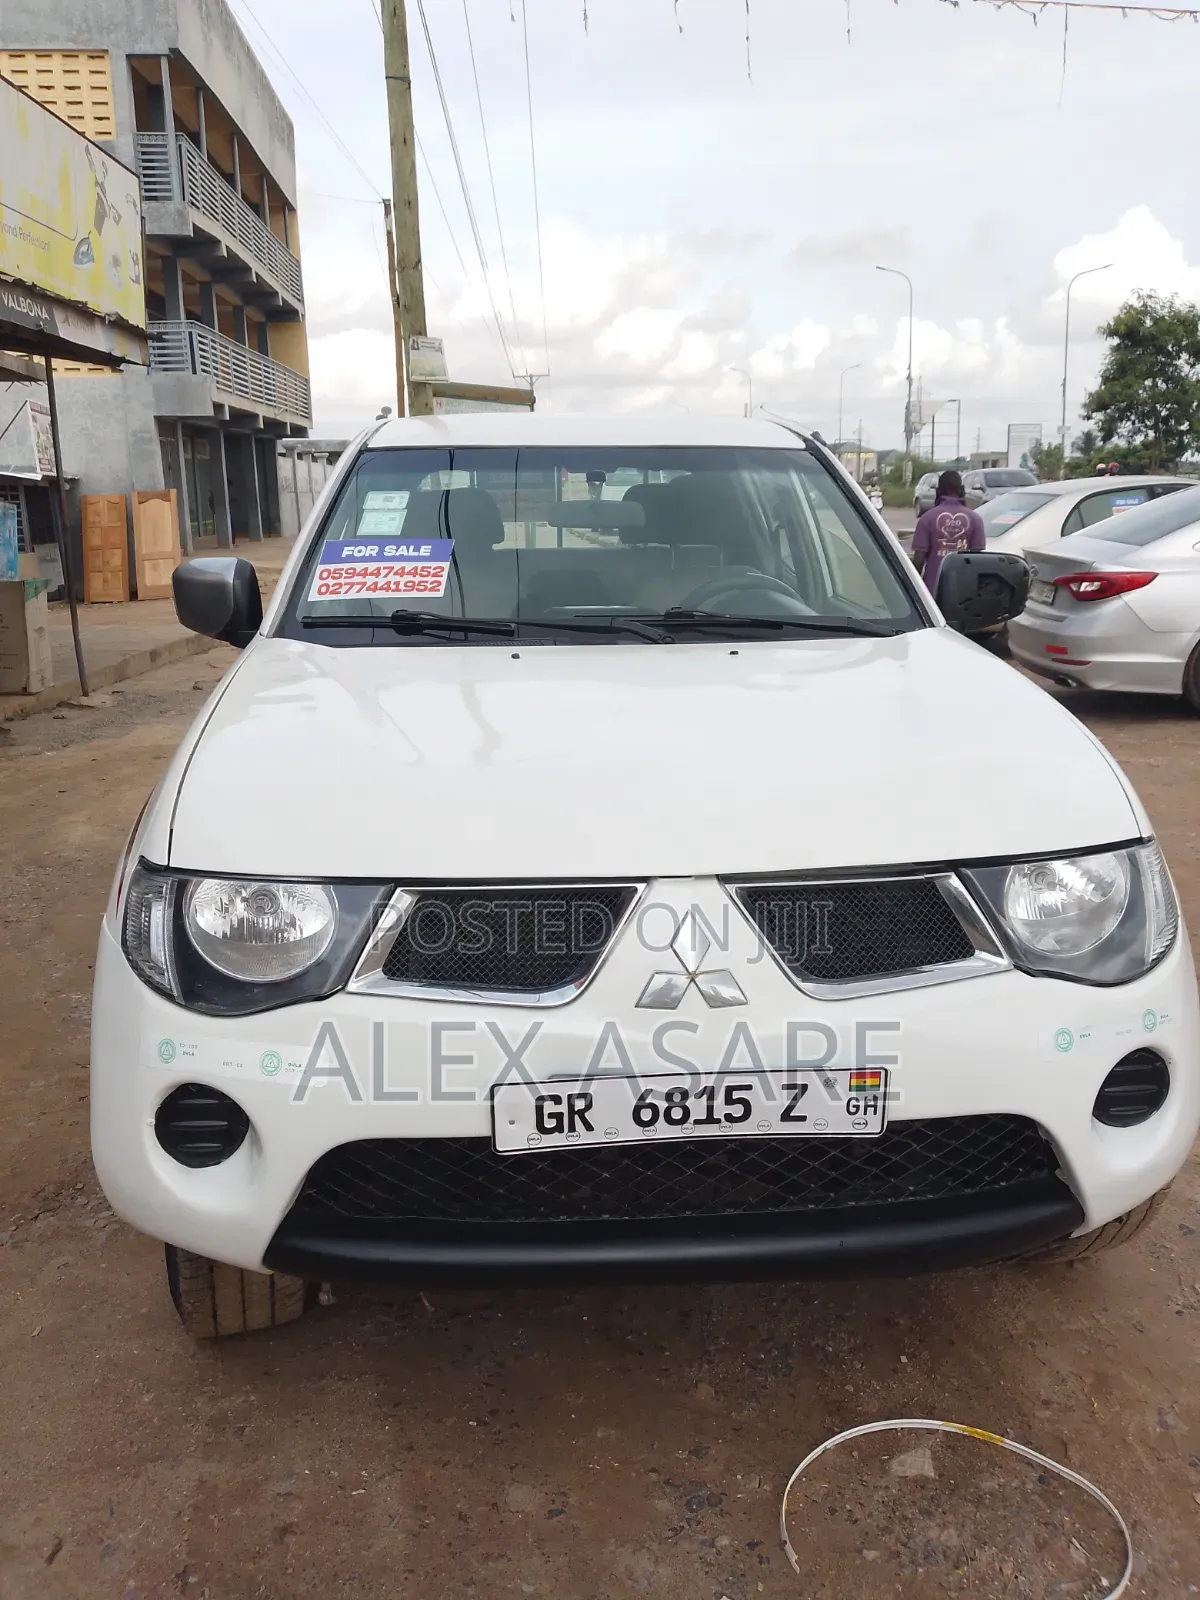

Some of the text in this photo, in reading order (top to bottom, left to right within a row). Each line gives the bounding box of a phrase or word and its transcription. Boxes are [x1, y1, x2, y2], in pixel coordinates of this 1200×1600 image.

[1, 291, 50, 320] VALBONA
[341, 545, 432, 558] FOR SALE
[318, 565, 445, 581] 0594474452
[316, 579, 442, 596] 0277441952
[534, 1082, 808, 1136] GR 6815 Z
[845, 1095, 879, 1117] GH
